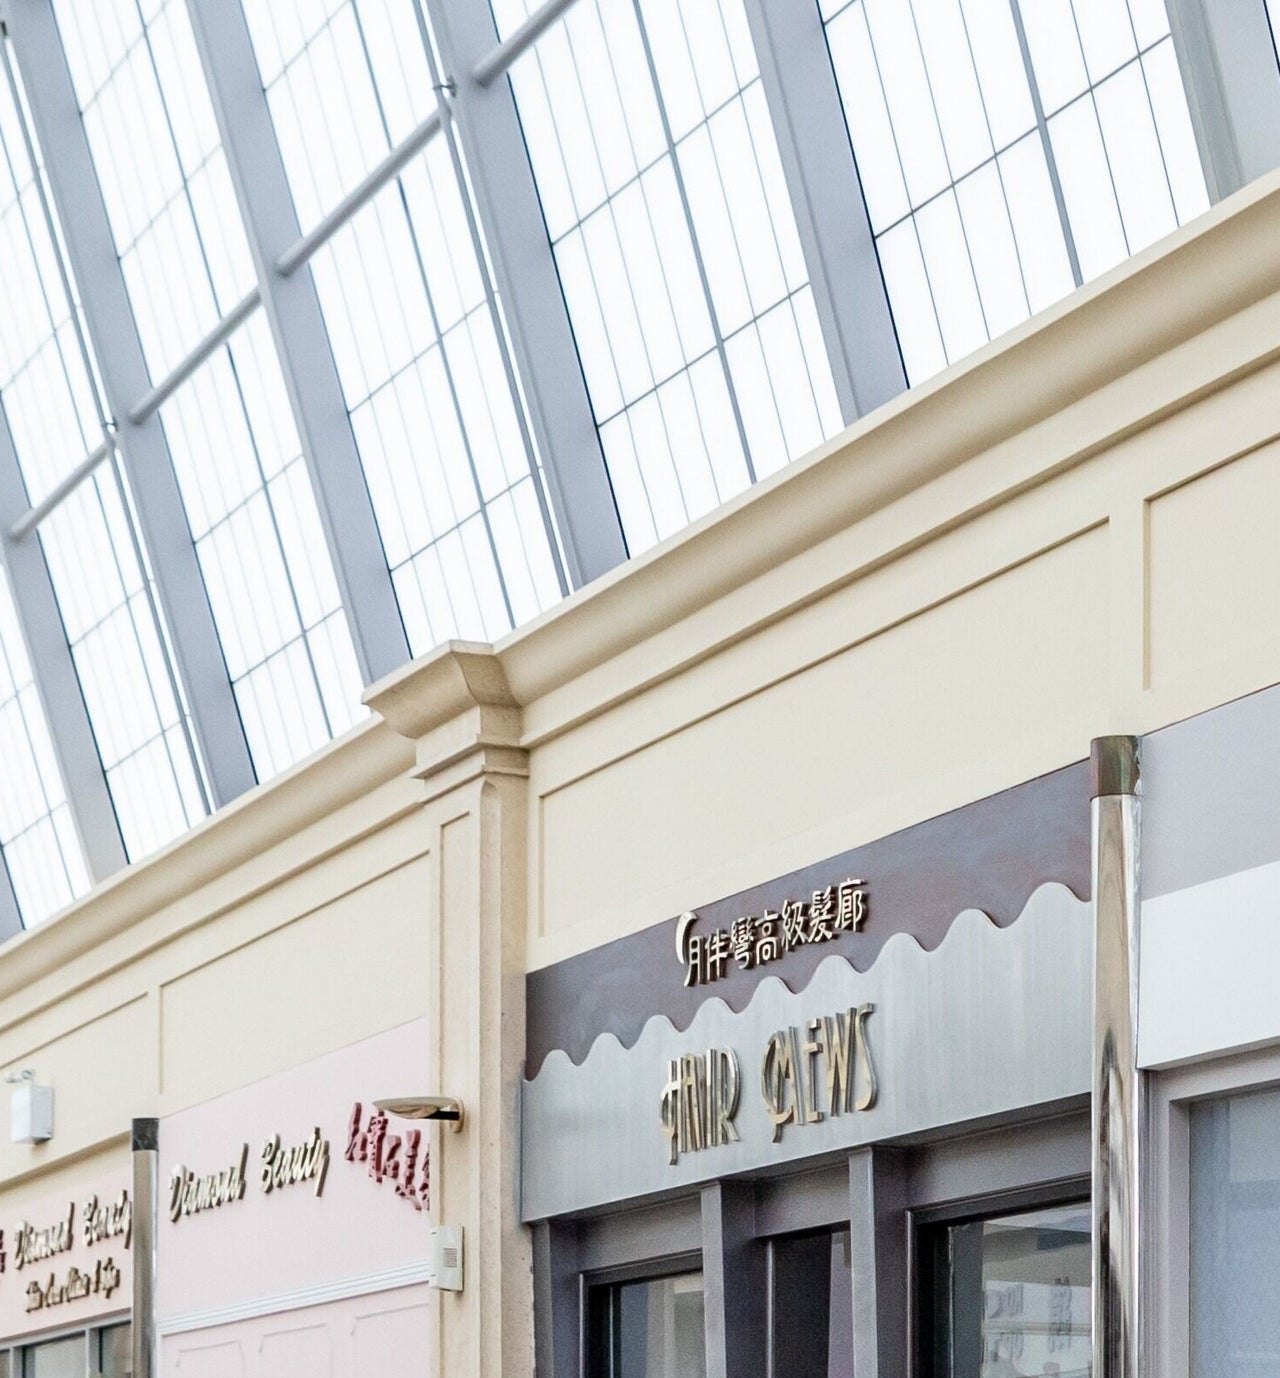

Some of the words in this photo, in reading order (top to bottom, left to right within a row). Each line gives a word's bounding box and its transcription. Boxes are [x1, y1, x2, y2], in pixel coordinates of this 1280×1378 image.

[660, 1043, 741, 1166] HAIR
[169, 1143, 248, 1223] Diamond
[261, 1126, 330, 1198] Beauty
[15, 1202, 74, 1270] Diamond
[82, 1190, 132, 1249] Beauty
